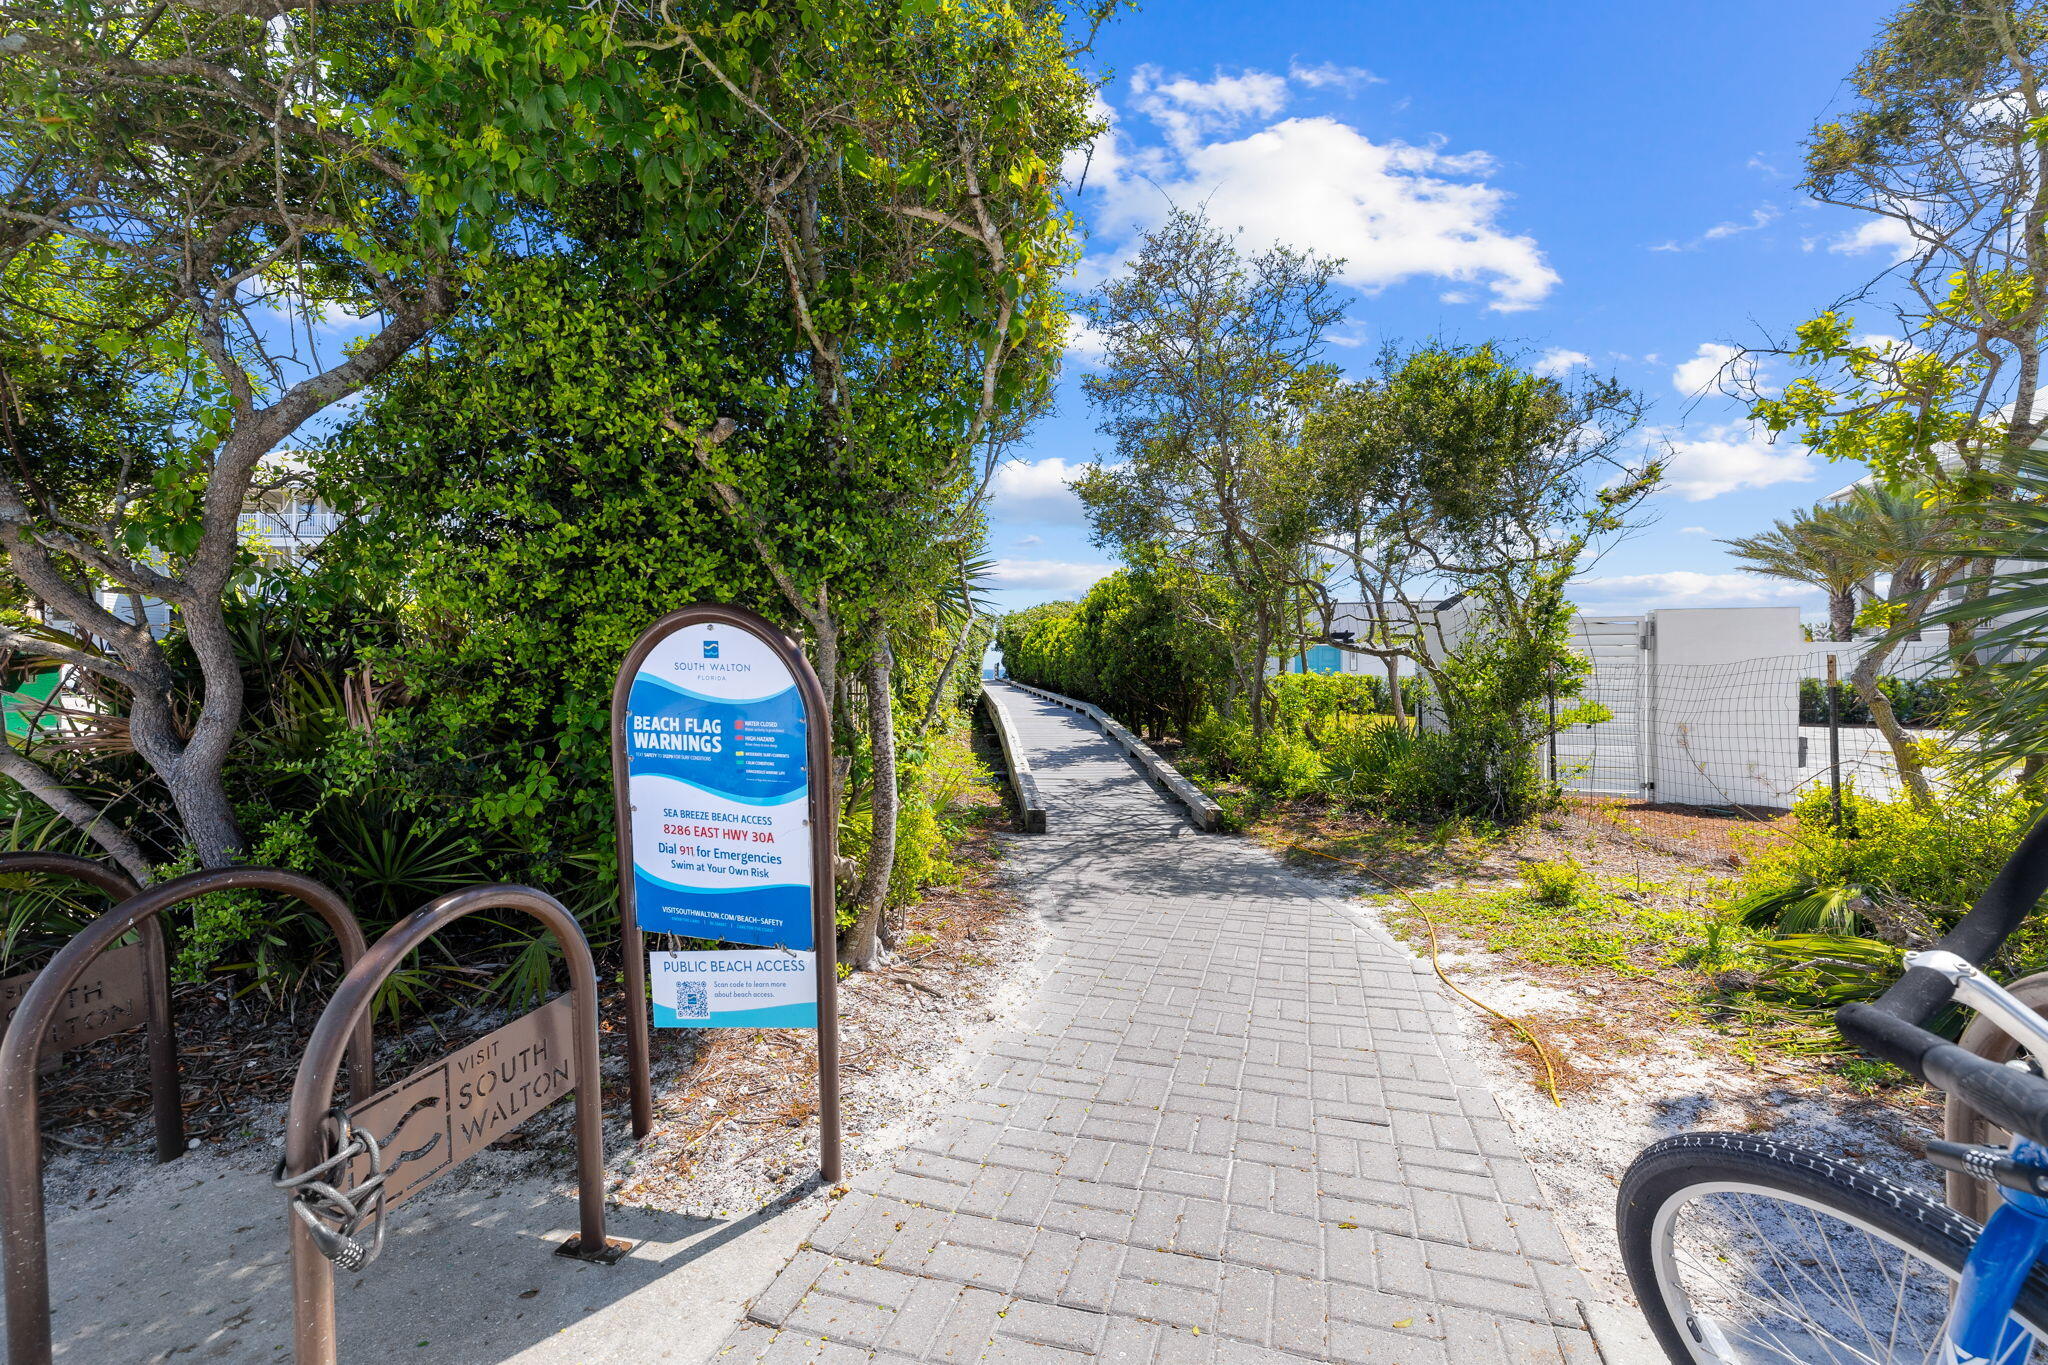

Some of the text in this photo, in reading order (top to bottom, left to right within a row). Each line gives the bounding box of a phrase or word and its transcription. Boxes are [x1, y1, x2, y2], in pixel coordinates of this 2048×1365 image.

[674, 662, 751, 672] SOUTH WALTON
[633, 715, 722, 734] BEACH FLAG
[633, 732, 722, 753] WARNINGS
[663, 808, 773, 826] SEA BREEZE BEACH ACCESS
[663, 823, 775, 843] 8286 EAST HWY 30A
[658, 842, 782, 865] Dial 911 for Emergencies
[671, 860, 770, 878] Swim at Your Own Risk
[662, 906, 783, 927] VISITSOUTHWALTON.COM/BEACH-SAFETY
[663, 959, 805, 973] PUBLIC BEACH ACCESS
[729, 980, 744, 988] code
[753, 980, 769, 988] learn
[714, 990, 732, 998] about
[733, 990, 752, 998] beach
[457, 1040, 500, 1075] VISIT
[459, 1039, 547, 1110] SOUTH
[461, 1060, 569, 1144] WALTON
